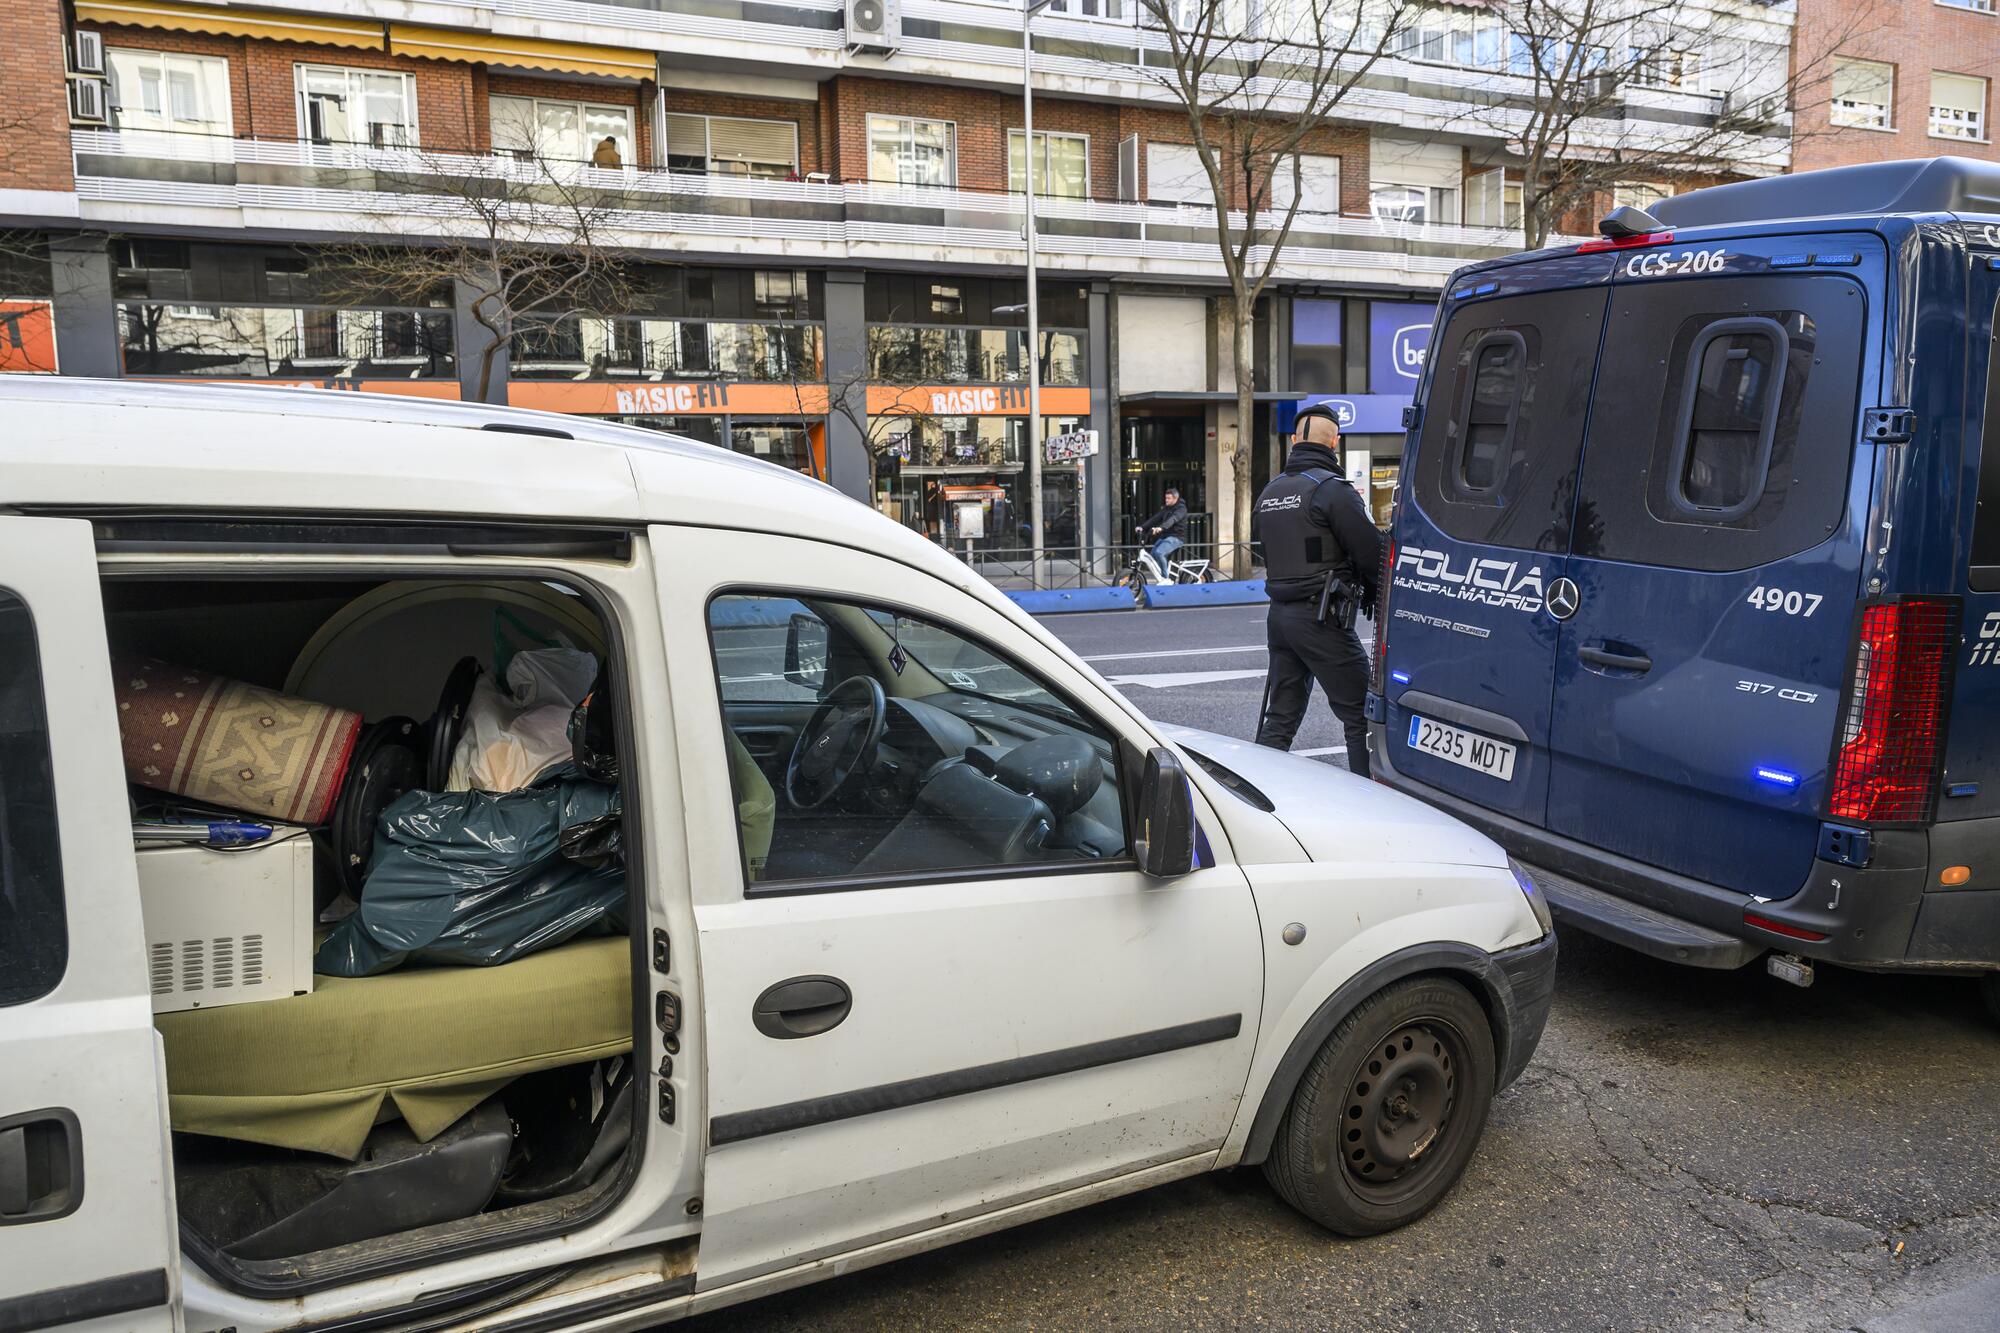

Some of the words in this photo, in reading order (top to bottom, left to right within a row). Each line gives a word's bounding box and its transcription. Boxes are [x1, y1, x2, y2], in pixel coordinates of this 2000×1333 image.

[1627, 248, 1726, 277] CCS-206
[616, 383, 729, 414] BASIC-FIT
[932, 386, 1027, 414] BASIC-FIT
[1393, 576, 1457, 598] MUNICIPAL
[1457, 585, 1543, 613] MADRID
[1747, 586, 1823, 617] 4907
[1394, 609, 1451, 630] SPRINTER
[1453, 624, 1490, 637] TOURER
[1736, 680, 1775, 694] 317
[1420, 723, 1465, 758] 2235
[1470, 738, 1510, 773] MDT
